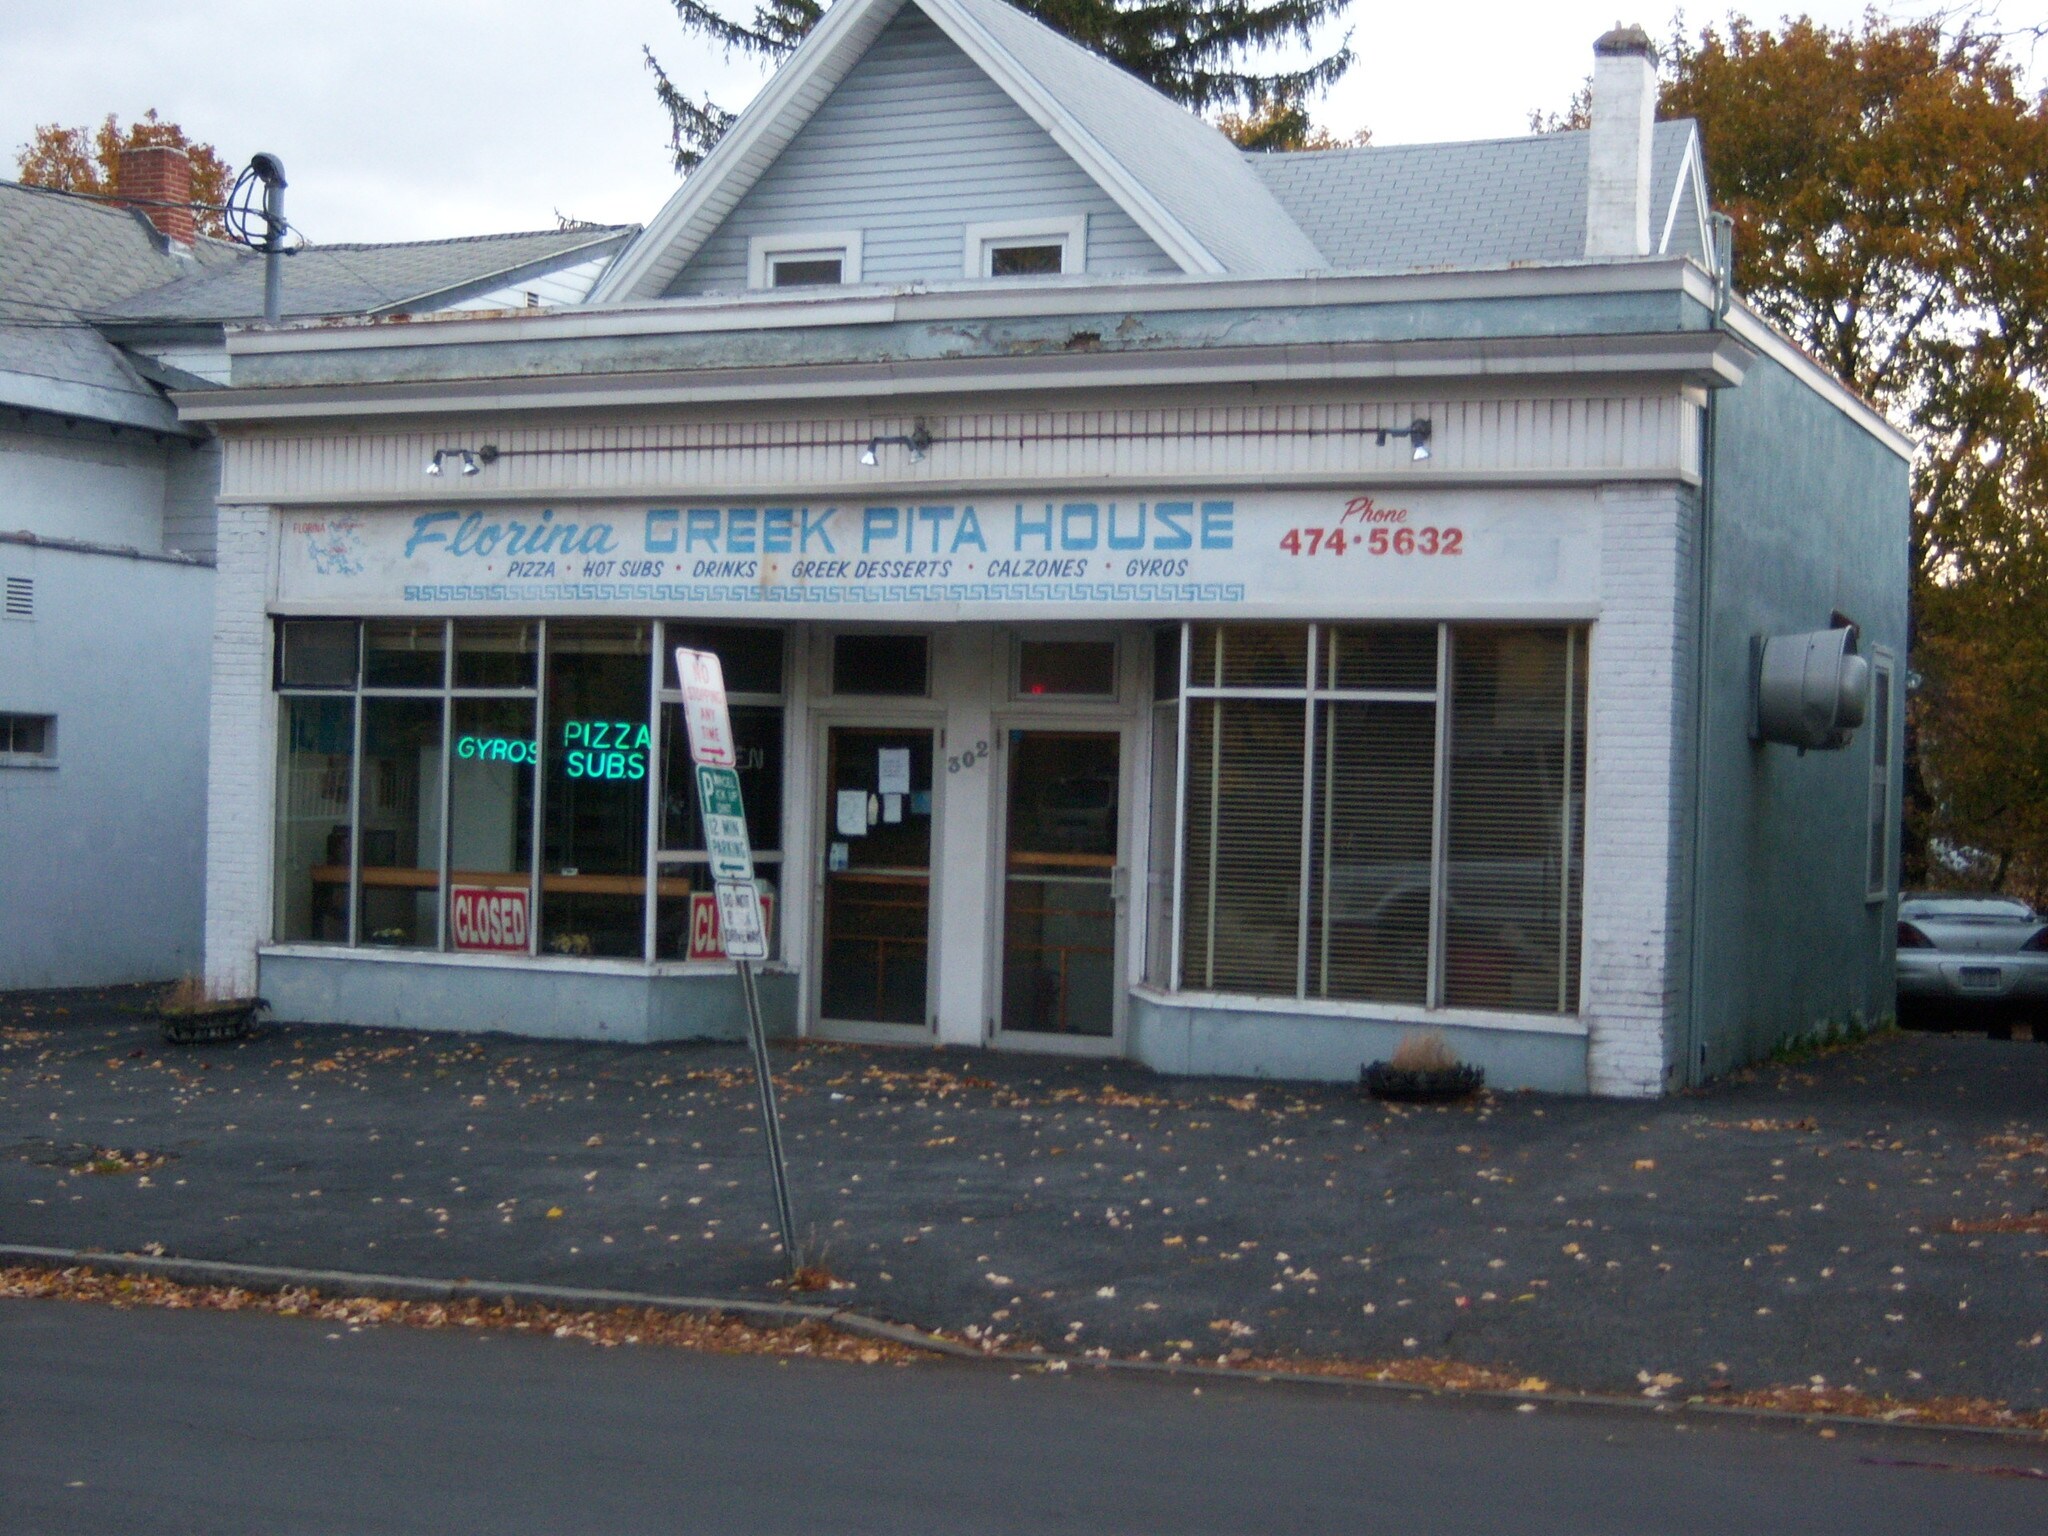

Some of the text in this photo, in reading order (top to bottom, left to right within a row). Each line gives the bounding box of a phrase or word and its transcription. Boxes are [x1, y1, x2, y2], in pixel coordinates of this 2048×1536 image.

[1340, 496, 1407, 524] Phone
[404, 501, 1234, 559] Florina GREEK PITA HOUSE
[507, 558, 1189, 578] PIZZA HOT SUBS DRINKS GREEK DESSERTS CALZONES GYROS
[564, 721, 652, 750] PIZZA
[458, 736, 537, 765] GYROS
[948, 740, 988, 774] 302
[567, 751, 645, 780] SUBS
[455, 895, 526, 947] CLOSED
